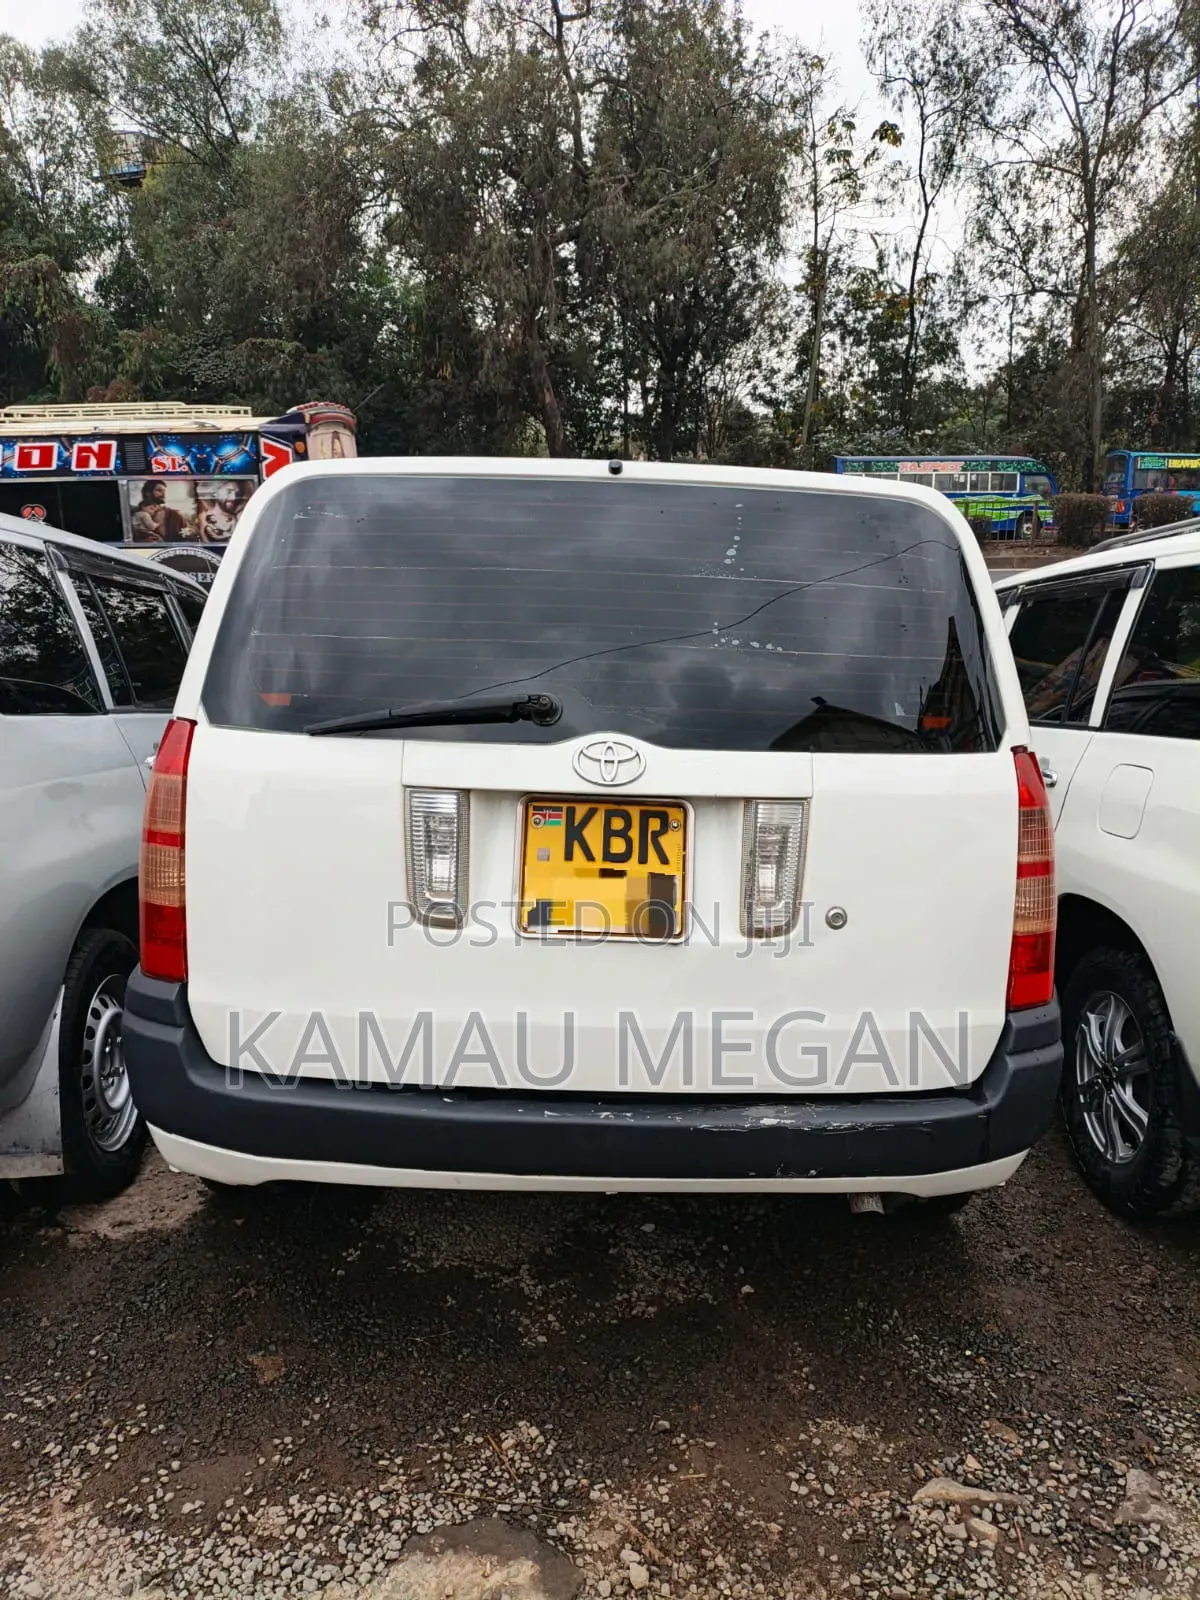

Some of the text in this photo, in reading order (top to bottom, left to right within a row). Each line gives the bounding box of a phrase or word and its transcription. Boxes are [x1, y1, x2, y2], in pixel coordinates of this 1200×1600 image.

[0, 440, 117, 471] ON
[151, 455, 189, 473] ST.
[563, 805, 670, 866] KBR
